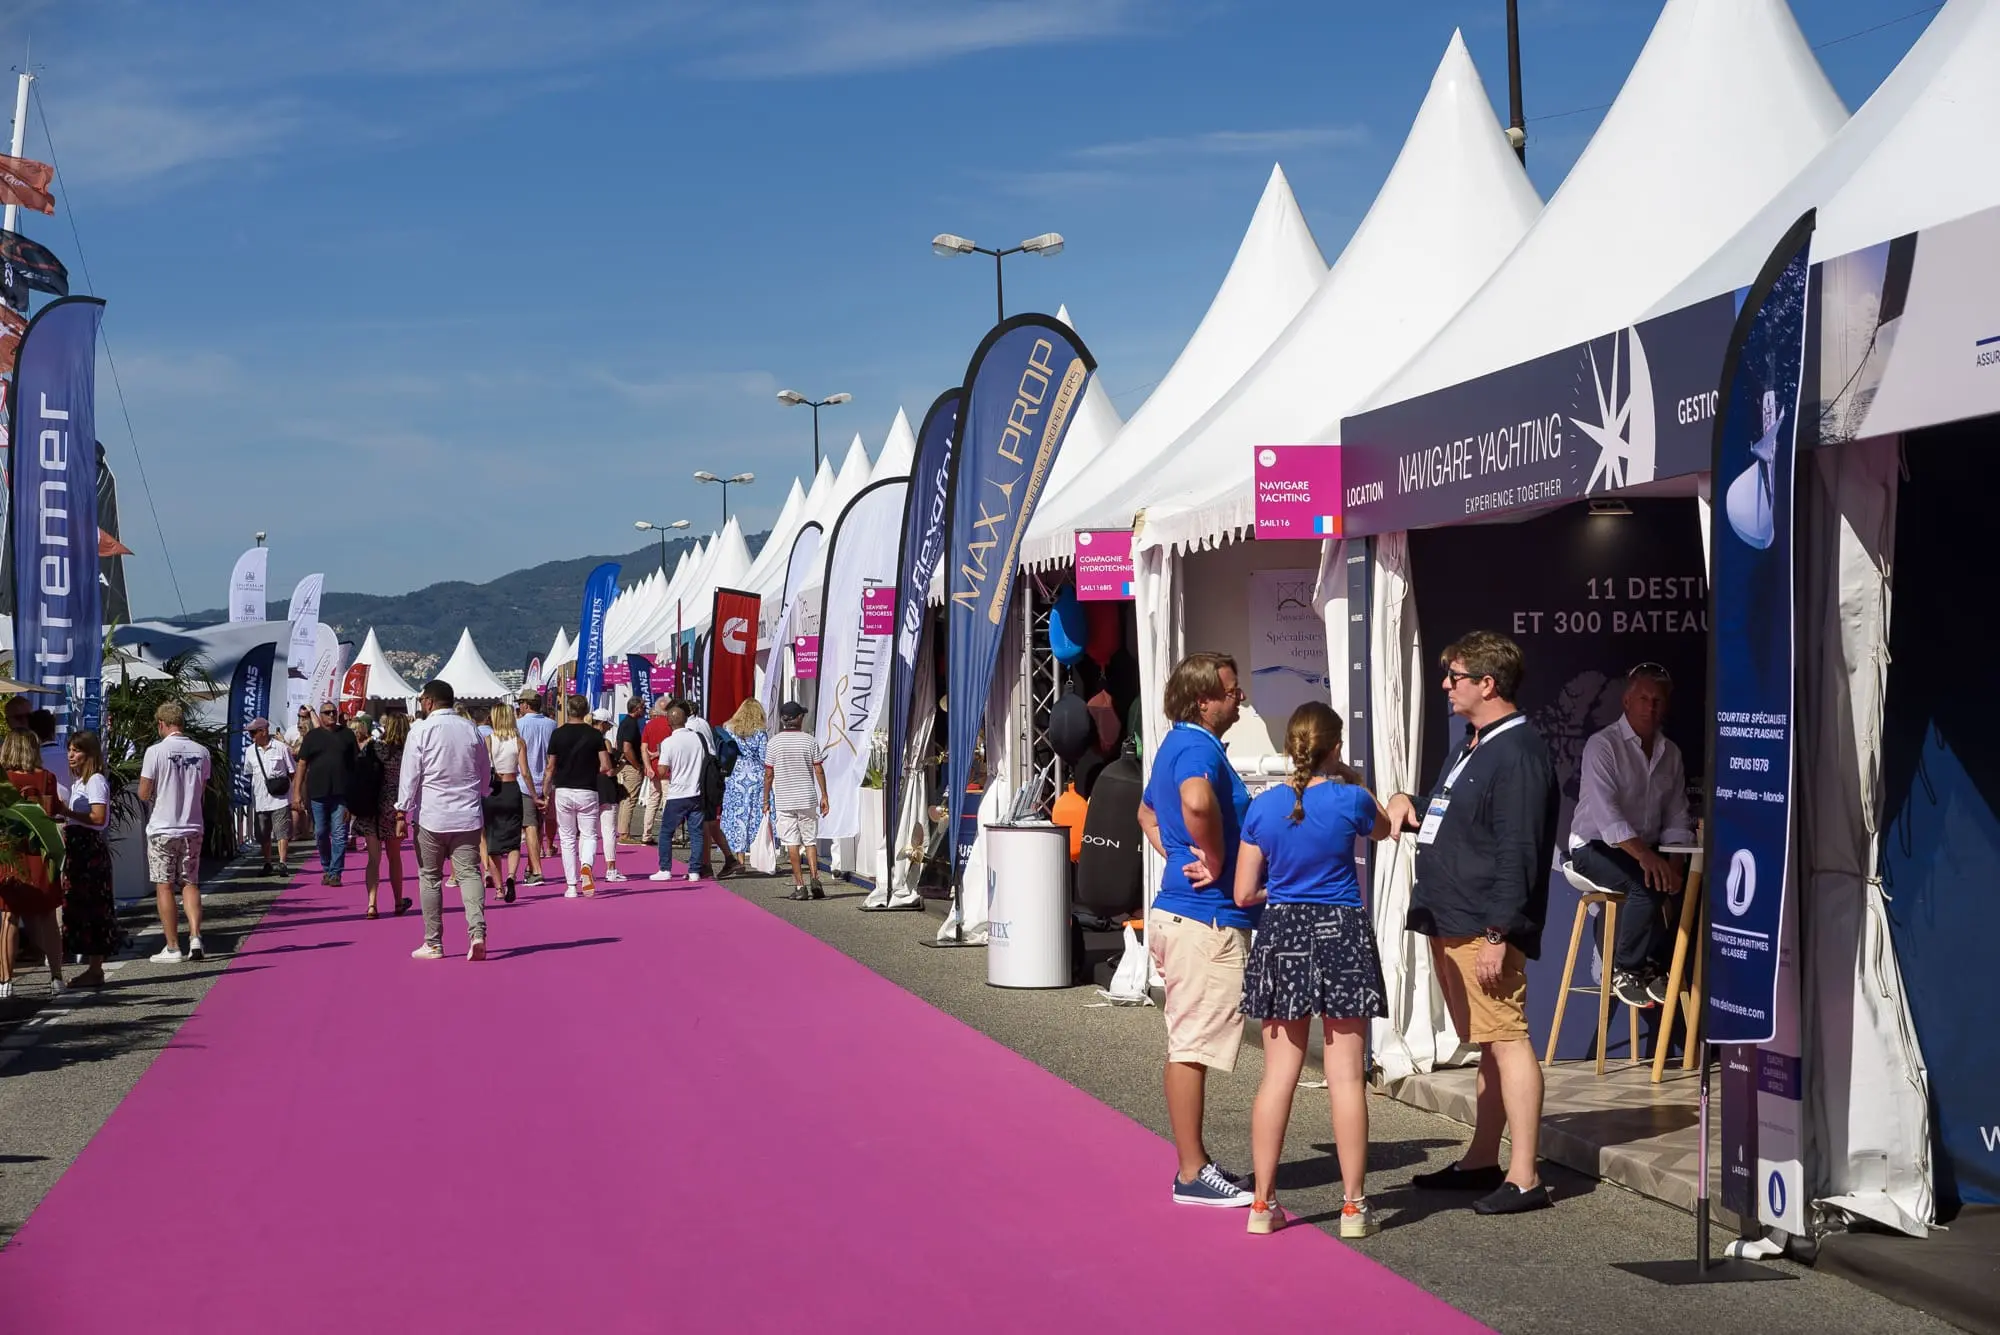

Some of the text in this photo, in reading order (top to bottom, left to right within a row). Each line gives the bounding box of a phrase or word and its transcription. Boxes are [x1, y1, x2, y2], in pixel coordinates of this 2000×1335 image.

[1043, 370, 1081, 454] PROPELLERS
[1398, 412, 1562, 495] NAVIGARE YACHTING
[952, 338, 1053, 611] MAX PROP
[1259, 481, 1309, 490] NAVIGARE
[1346, 481, 1384, 507] LOCATION
[1259, 493, 1311, 502] YACHTING
[1465, 479, 1562, 514] EXPERIENCE TOGETHER
[1260, 519, 1290, 527] SAIL116
[1079, 555, 1123, 563] COMPAGNIE
[1586, 577, 1703, 599] 11 DESTI
[1513, 611, 1544, 634] ET
[1554, 611, 1601, 633] 300
[586, 598, 603, 675] PANTAENIUS
[1717, 711, 1787, 725] COURTIER SPÉCIALISTE
[1719, 726, 1784, 740] ASSURANCE PLAISANCE
[1729, 756, 1770, 772] DEPUIS 1978
[1716, 786, 1733, 800] Europe
[1737, 788, 1758, 801] Antilles
[1762, 791, 1785, 803] Monde
[1737, 937, 1769, 951] MARITIMES
